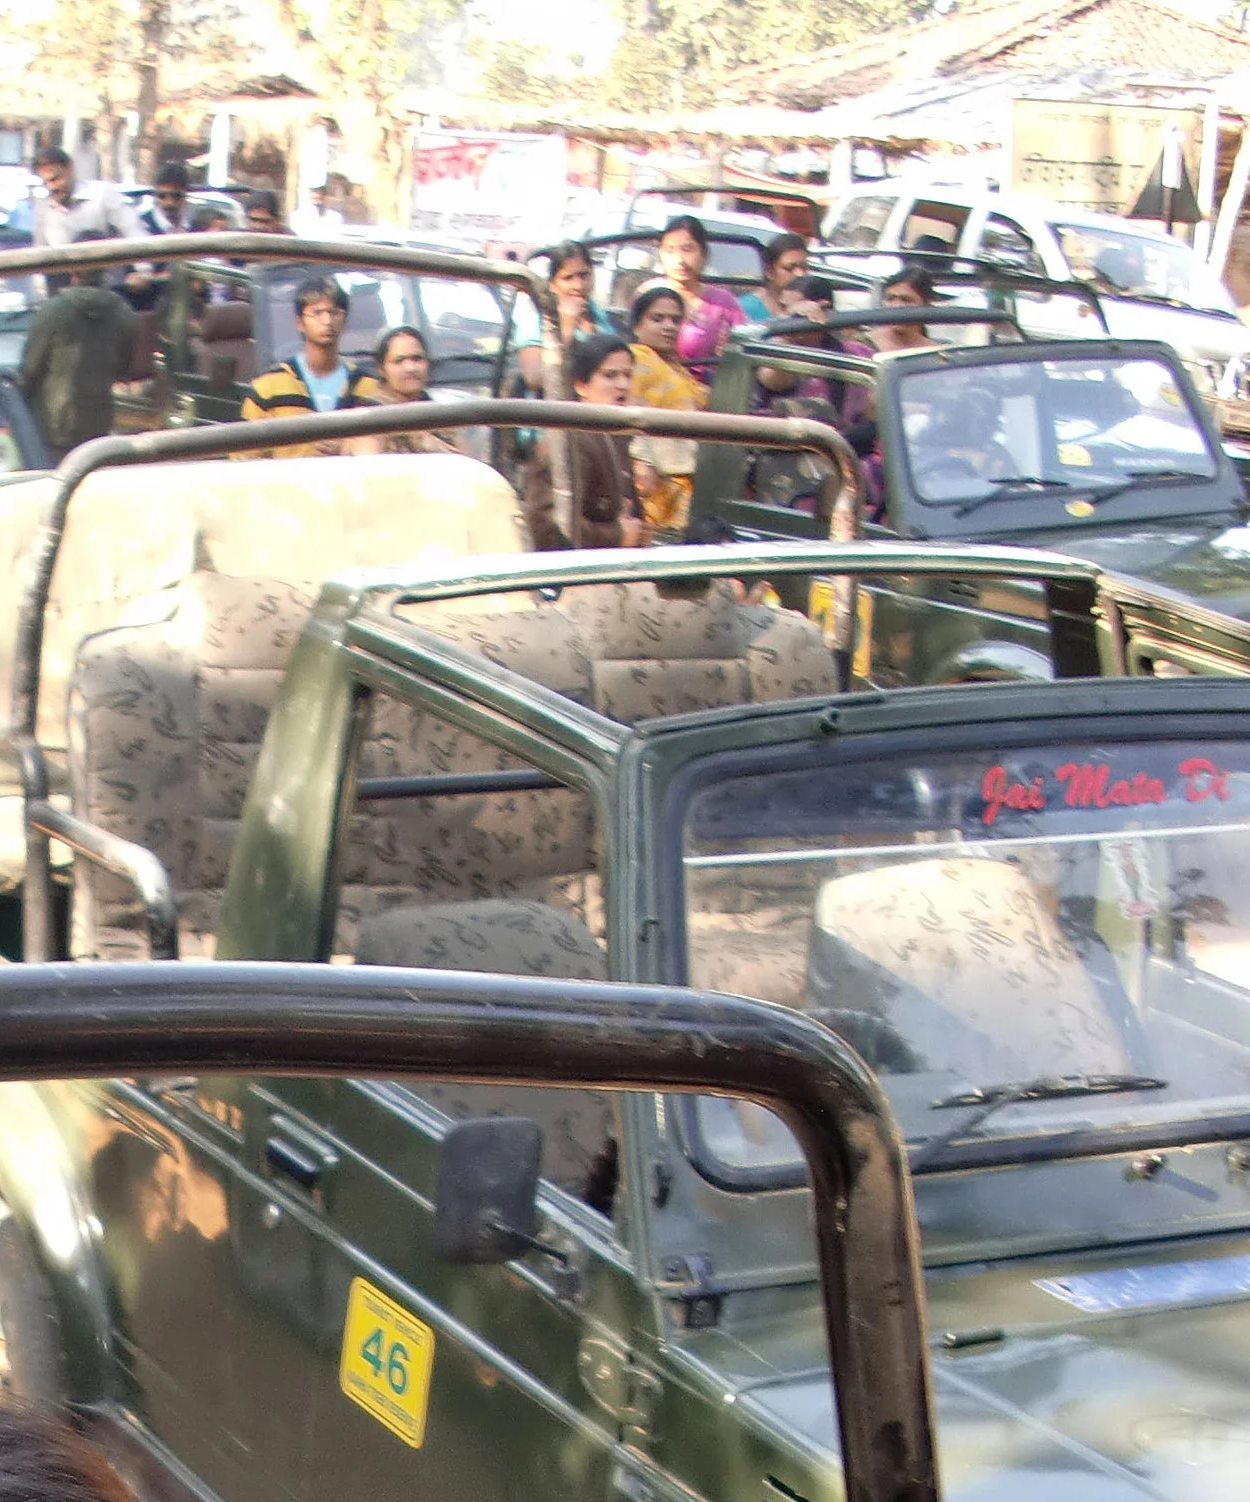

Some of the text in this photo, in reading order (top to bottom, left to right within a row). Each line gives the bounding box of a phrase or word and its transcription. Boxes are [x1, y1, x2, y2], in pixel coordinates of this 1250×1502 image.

[981, 756, 1232, 827] Jai Mata Di
[361, 1328, 410, 1396] 46
